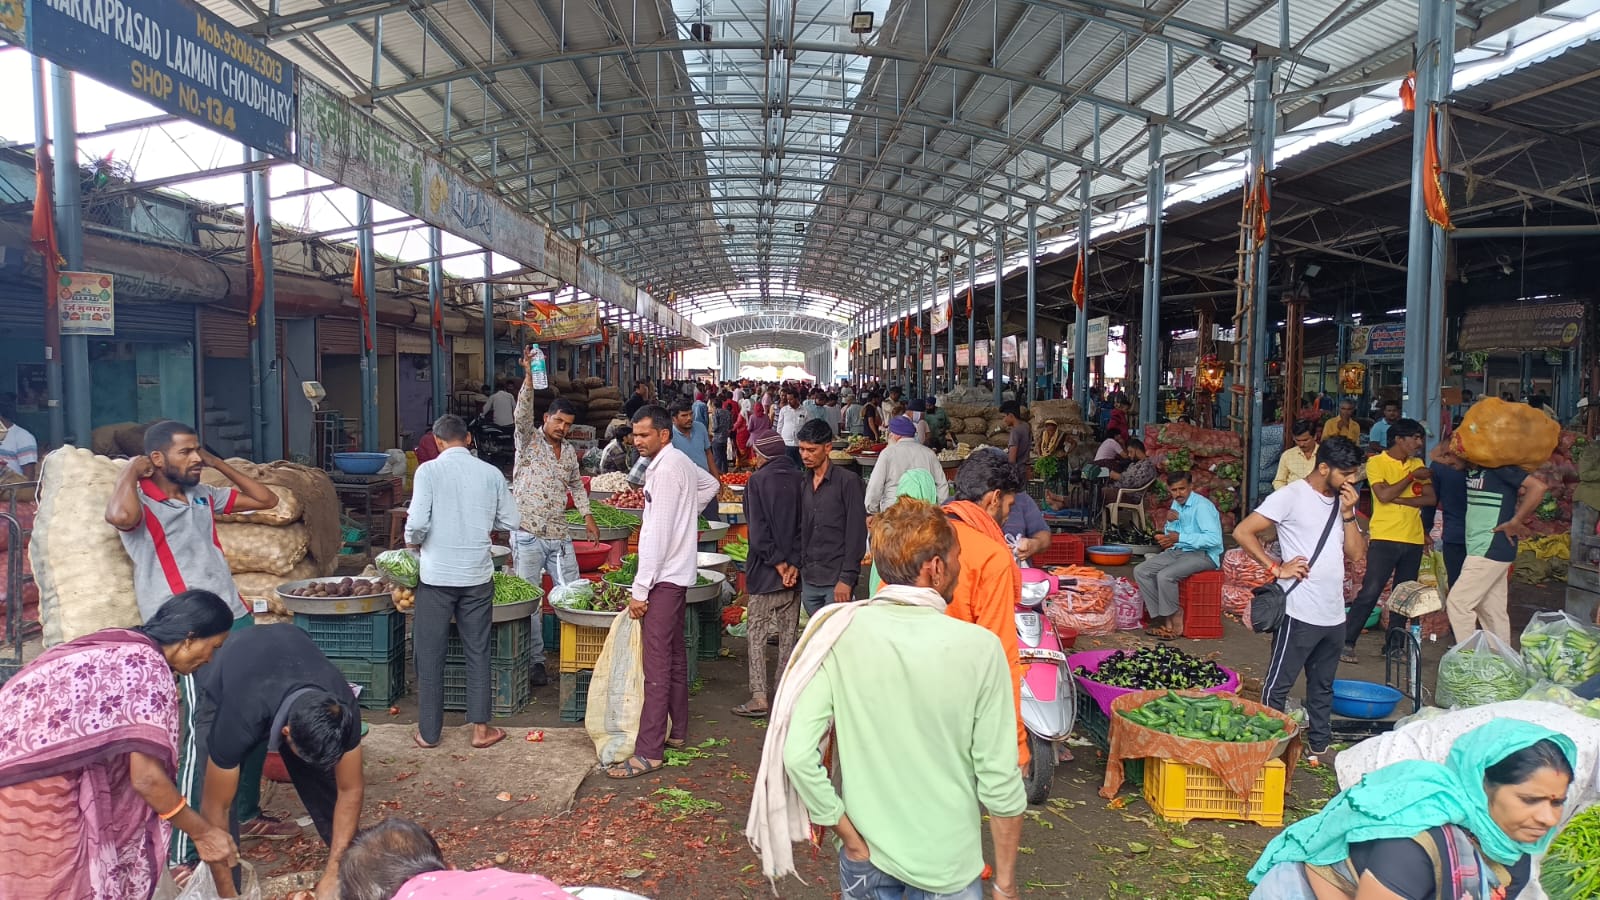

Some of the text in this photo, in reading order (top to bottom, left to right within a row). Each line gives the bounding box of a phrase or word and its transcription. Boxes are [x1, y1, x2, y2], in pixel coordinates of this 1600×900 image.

[45, 0, 291, 126] RKAPRASAD LAXMAN CHOUDHARY
[131, 59, 173, 101] SHOP
